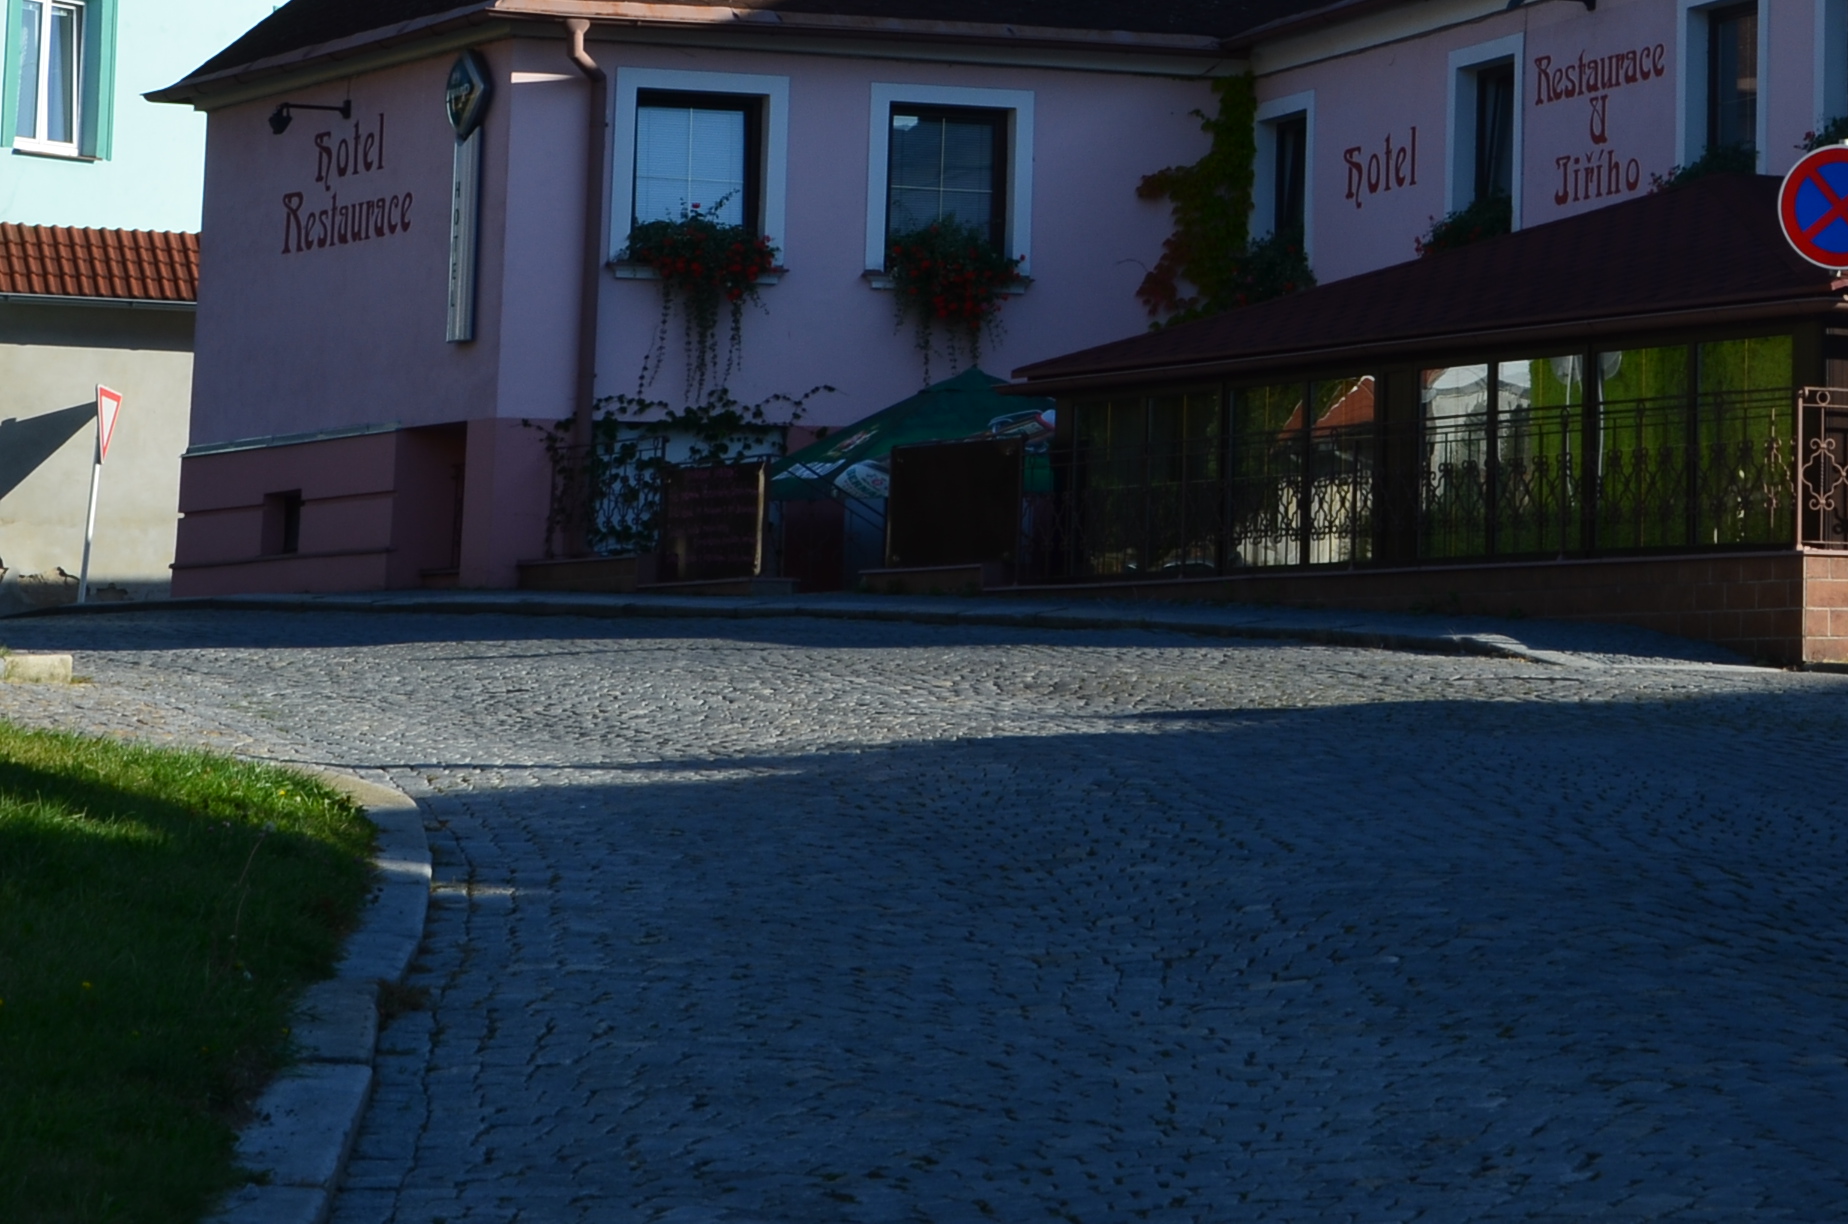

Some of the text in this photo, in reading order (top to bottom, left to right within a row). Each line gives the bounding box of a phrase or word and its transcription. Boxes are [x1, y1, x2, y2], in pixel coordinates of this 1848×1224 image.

[1534, 43, 1666, 106] Restaurace
[314, 113, 385, 191] Hotel
[1343, 126, 1418, 209] Hotel
[281, 191, 413, 254] Restaurace
